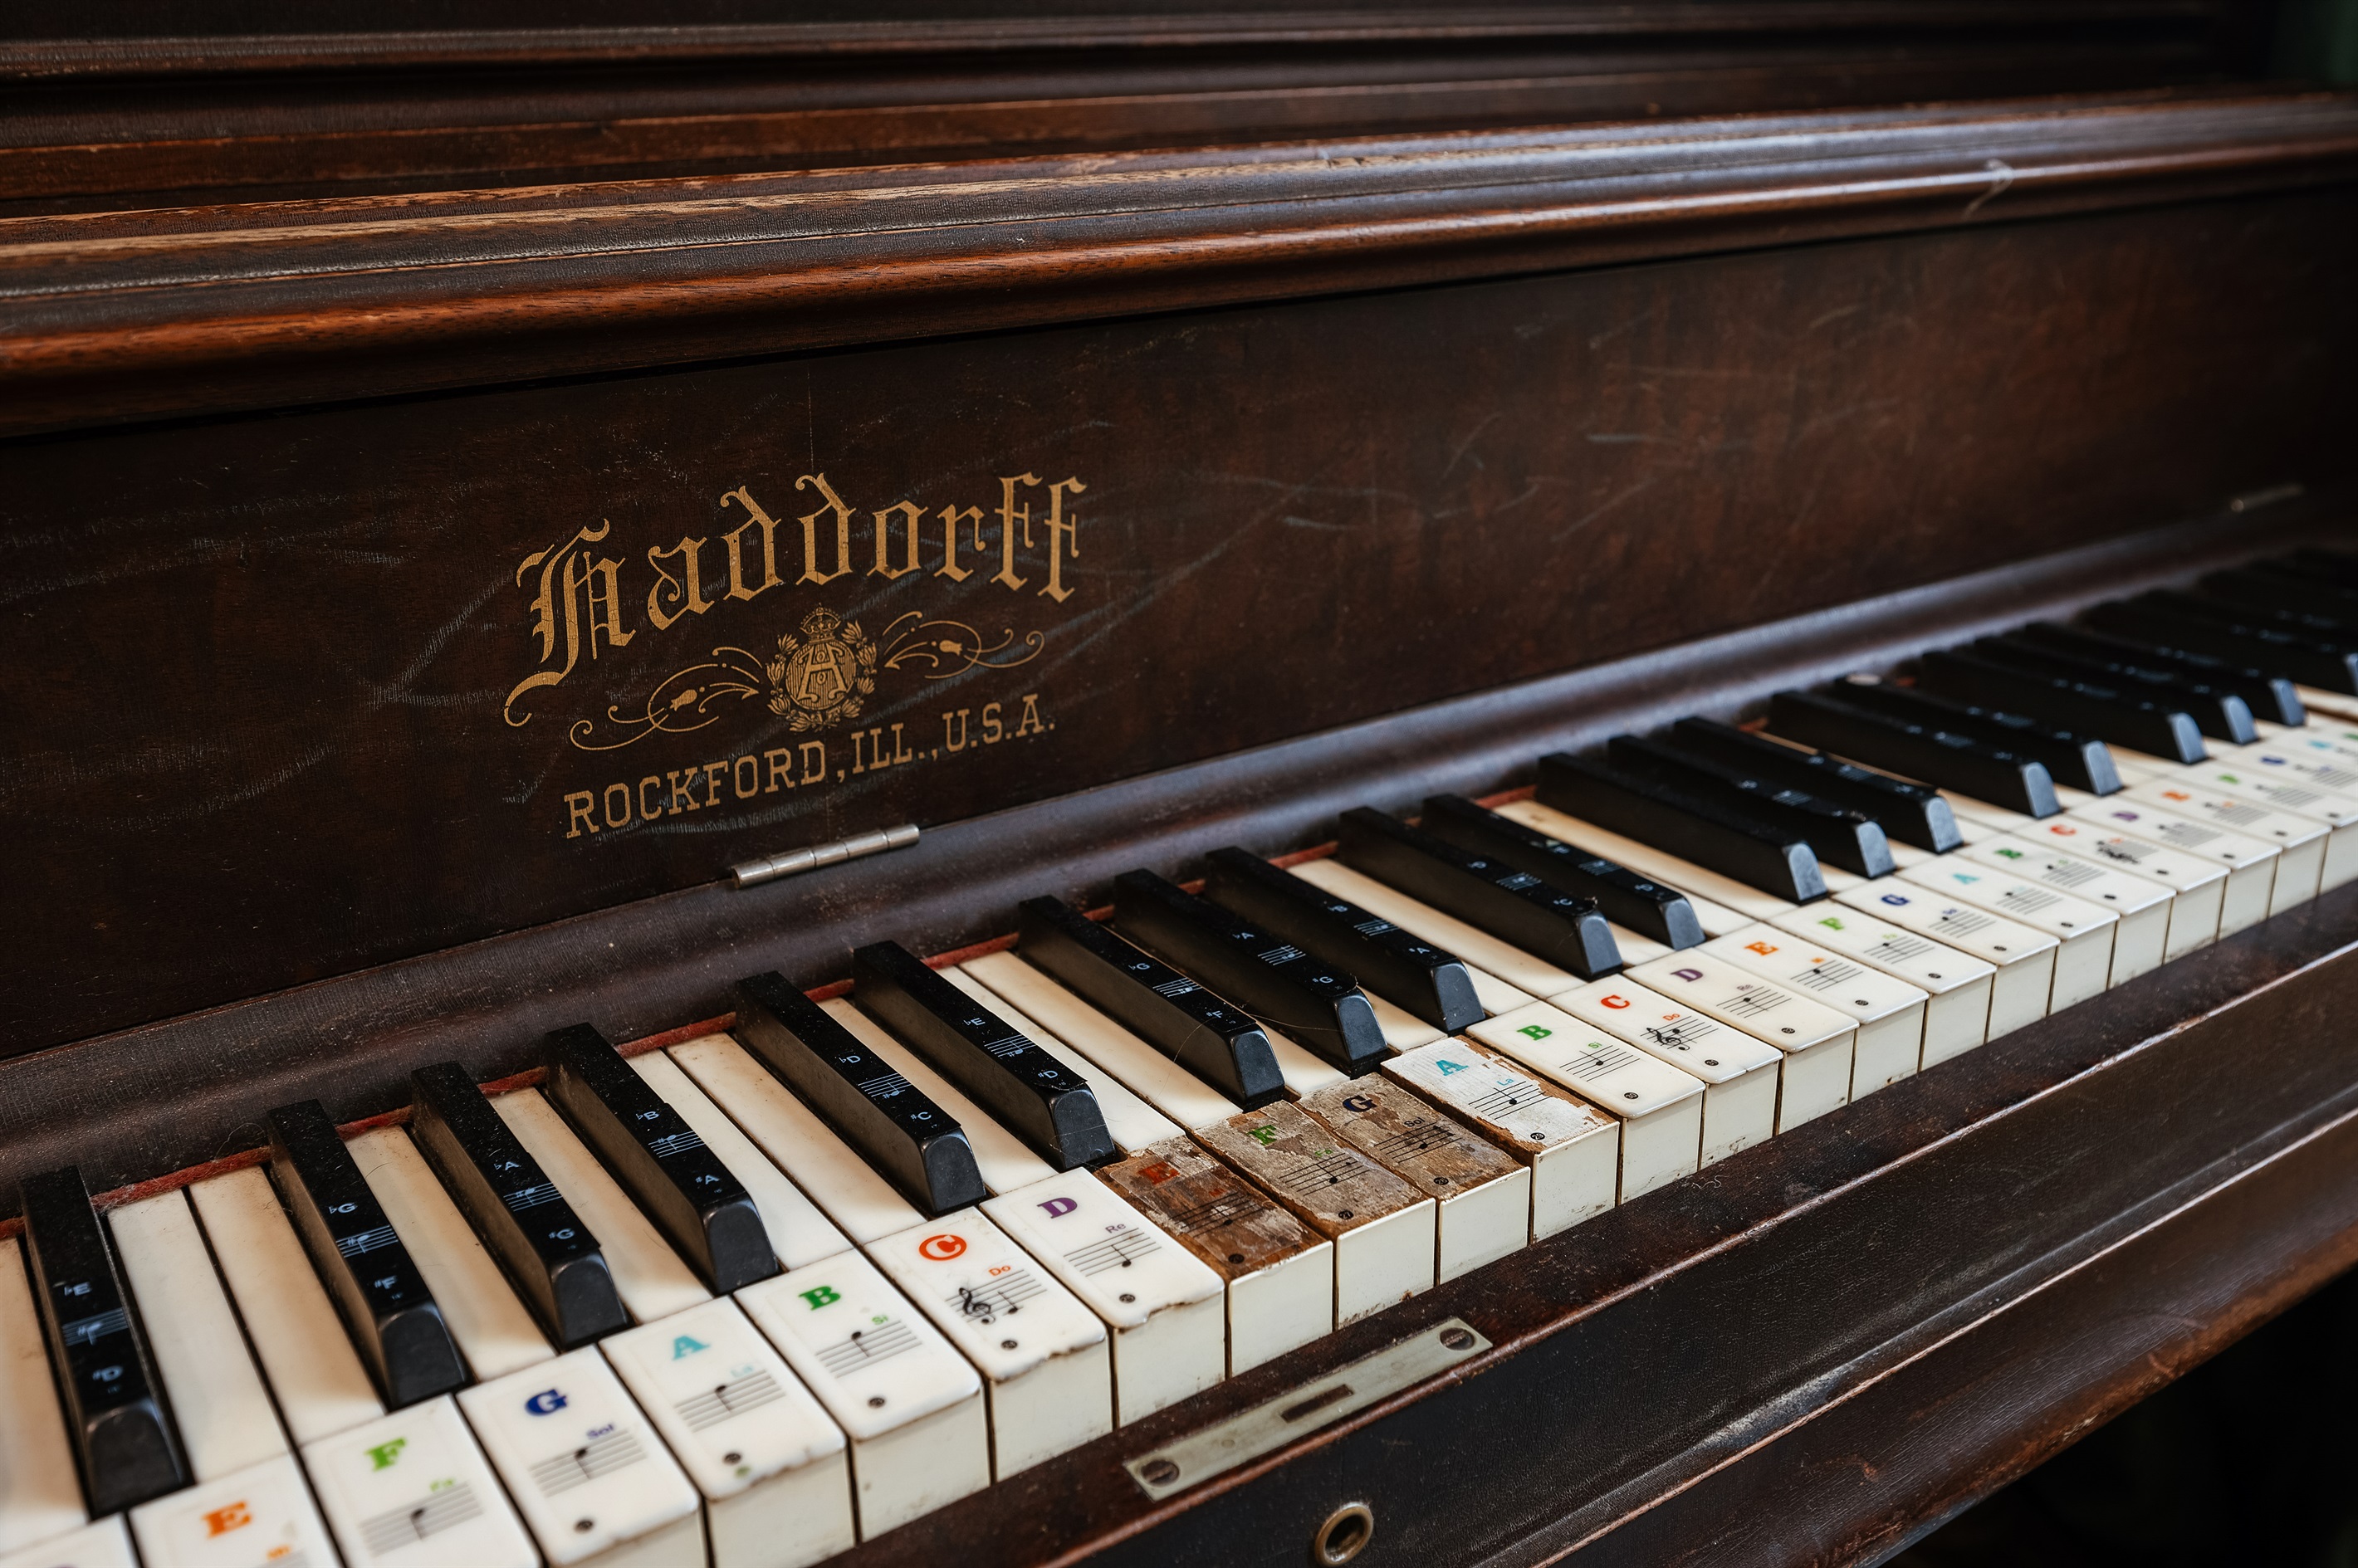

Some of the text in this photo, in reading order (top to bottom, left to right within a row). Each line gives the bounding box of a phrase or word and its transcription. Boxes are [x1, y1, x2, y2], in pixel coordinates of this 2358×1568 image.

[504, 471, 1088, 727] Haddorff
[1744, 941, 1779, 956] E
[1670, 969, 1704, 982] D
[1601, 994, 1631, 1009] C
[1662, 1013, 1680, 1021] Do
[1516, 1025, 1553, 1041] B
[1588, 1041, 1602, 1049] Si
[1436, 1059, 1469, 1077] A
[1497, 1077, 1514, 1087] La
[1343, 1095, 1377, 1112] G
[1404, 1116, 1426, 1128] Sol
[1247, 1125, 1277, 1145] F
[1530, 1132, 1545, 1141] 29
[1036, 1197, 1078, 1219] D
[1105, 1224, 1127, 1233] Re
[921, 1234, 965, 1261] C
[989, 1265, 1010, 1277] Do
[797, 1285, 841, 1311] B
[672, 1336, 711, 1360] A
[525, 1389, 568, 1416] G
[364, 1437, 408, 1473] F
[202, 1501, 252, 1539] E
